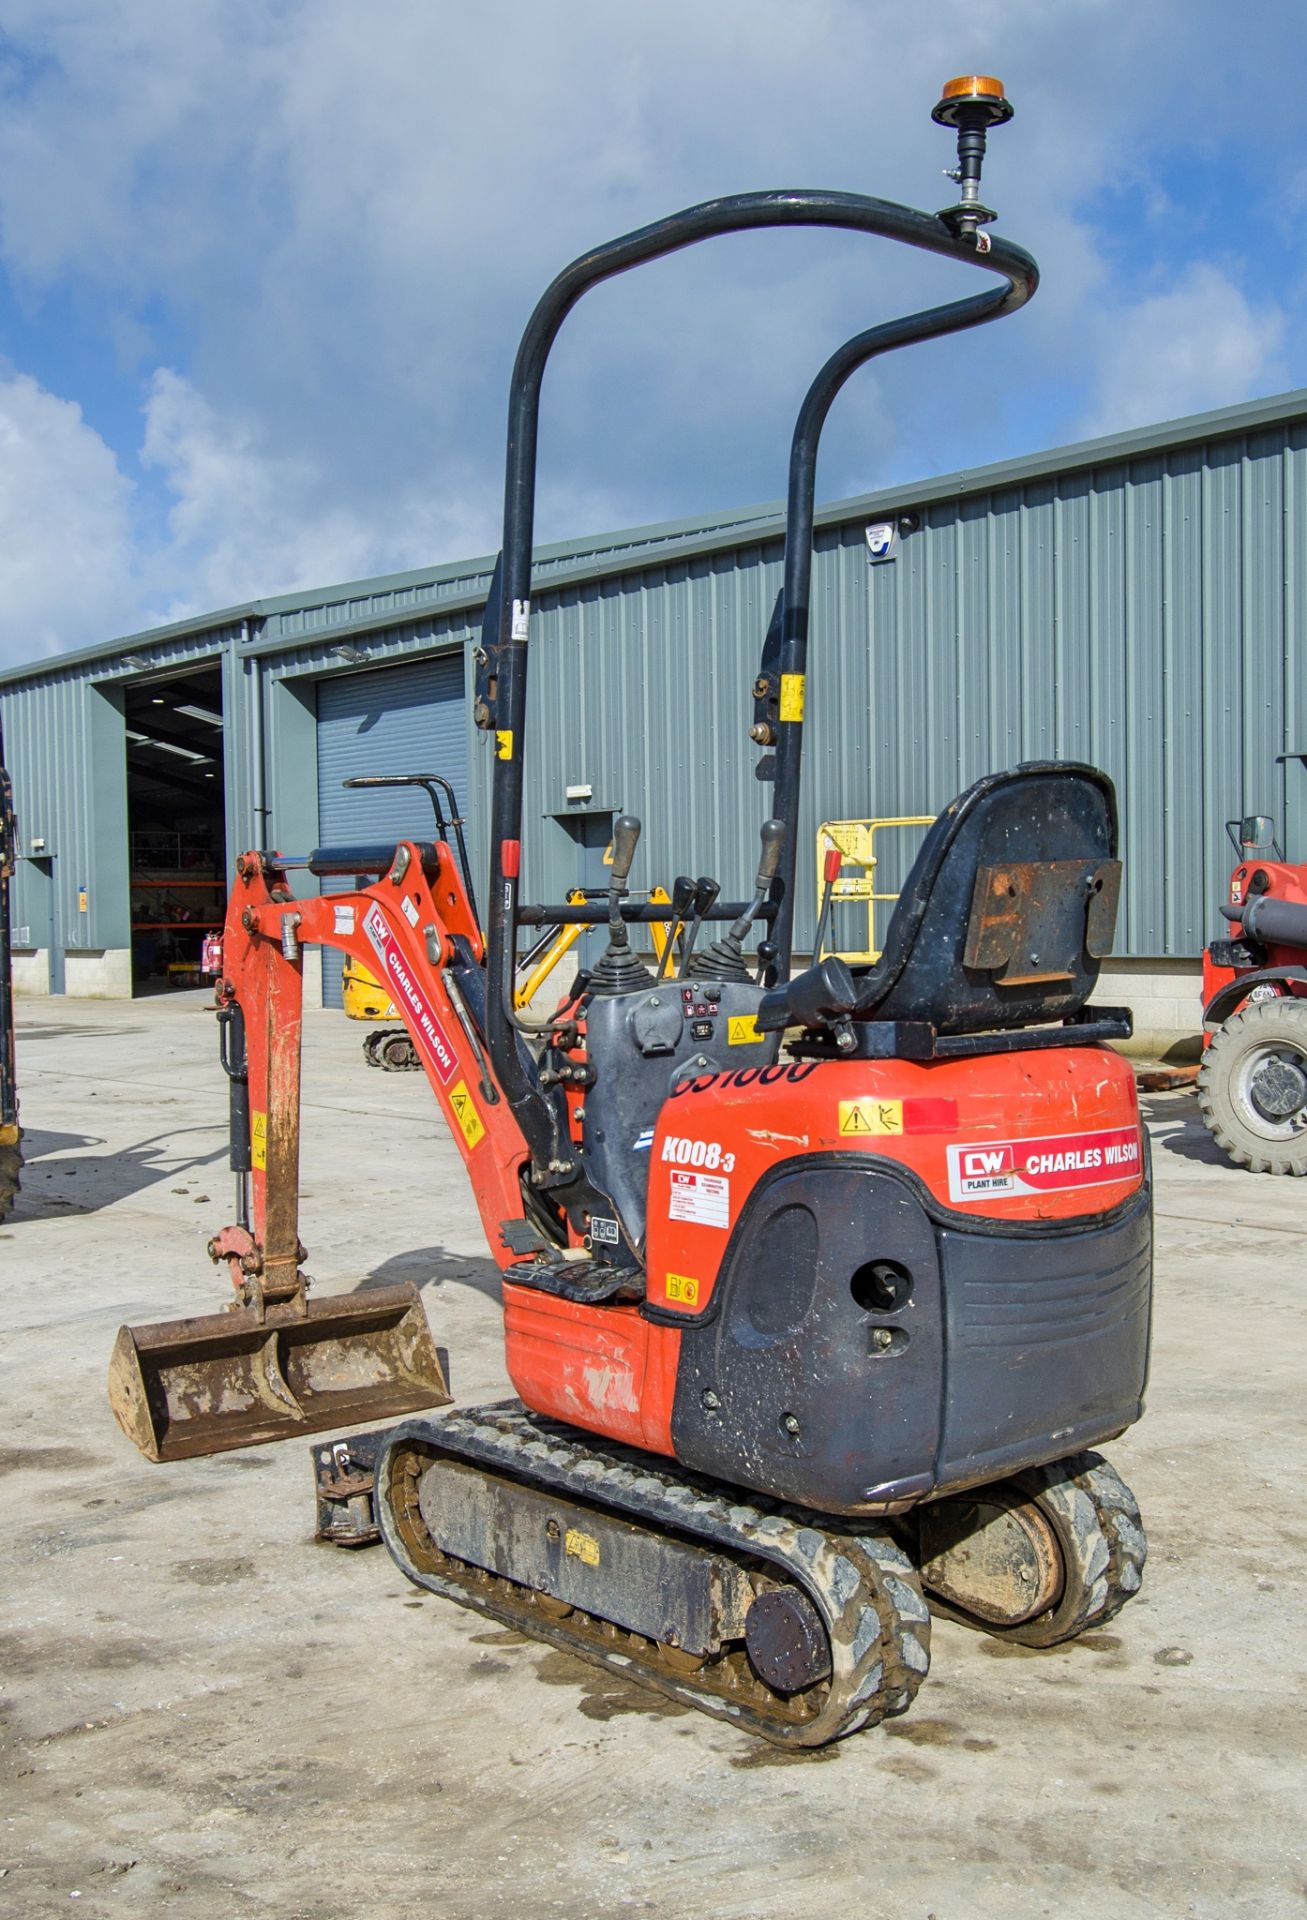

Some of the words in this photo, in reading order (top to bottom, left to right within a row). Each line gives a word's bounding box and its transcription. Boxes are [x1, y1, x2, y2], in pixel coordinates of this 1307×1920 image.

[389, 952, 423, 1015] CHARLES
[420, 1012, 452, 1069] WILSON
[661, 1135, 736, 1173] K008-3
[964, 1151, 1005, 1176] CW
[1026, 1148, 1102, 1175] CHARLES
[1104, 1142, 1138, 1165] WILSON
[967, 1179, 990, 1190] PLANT
[992, 1177, 1008, 1187] HIRE
